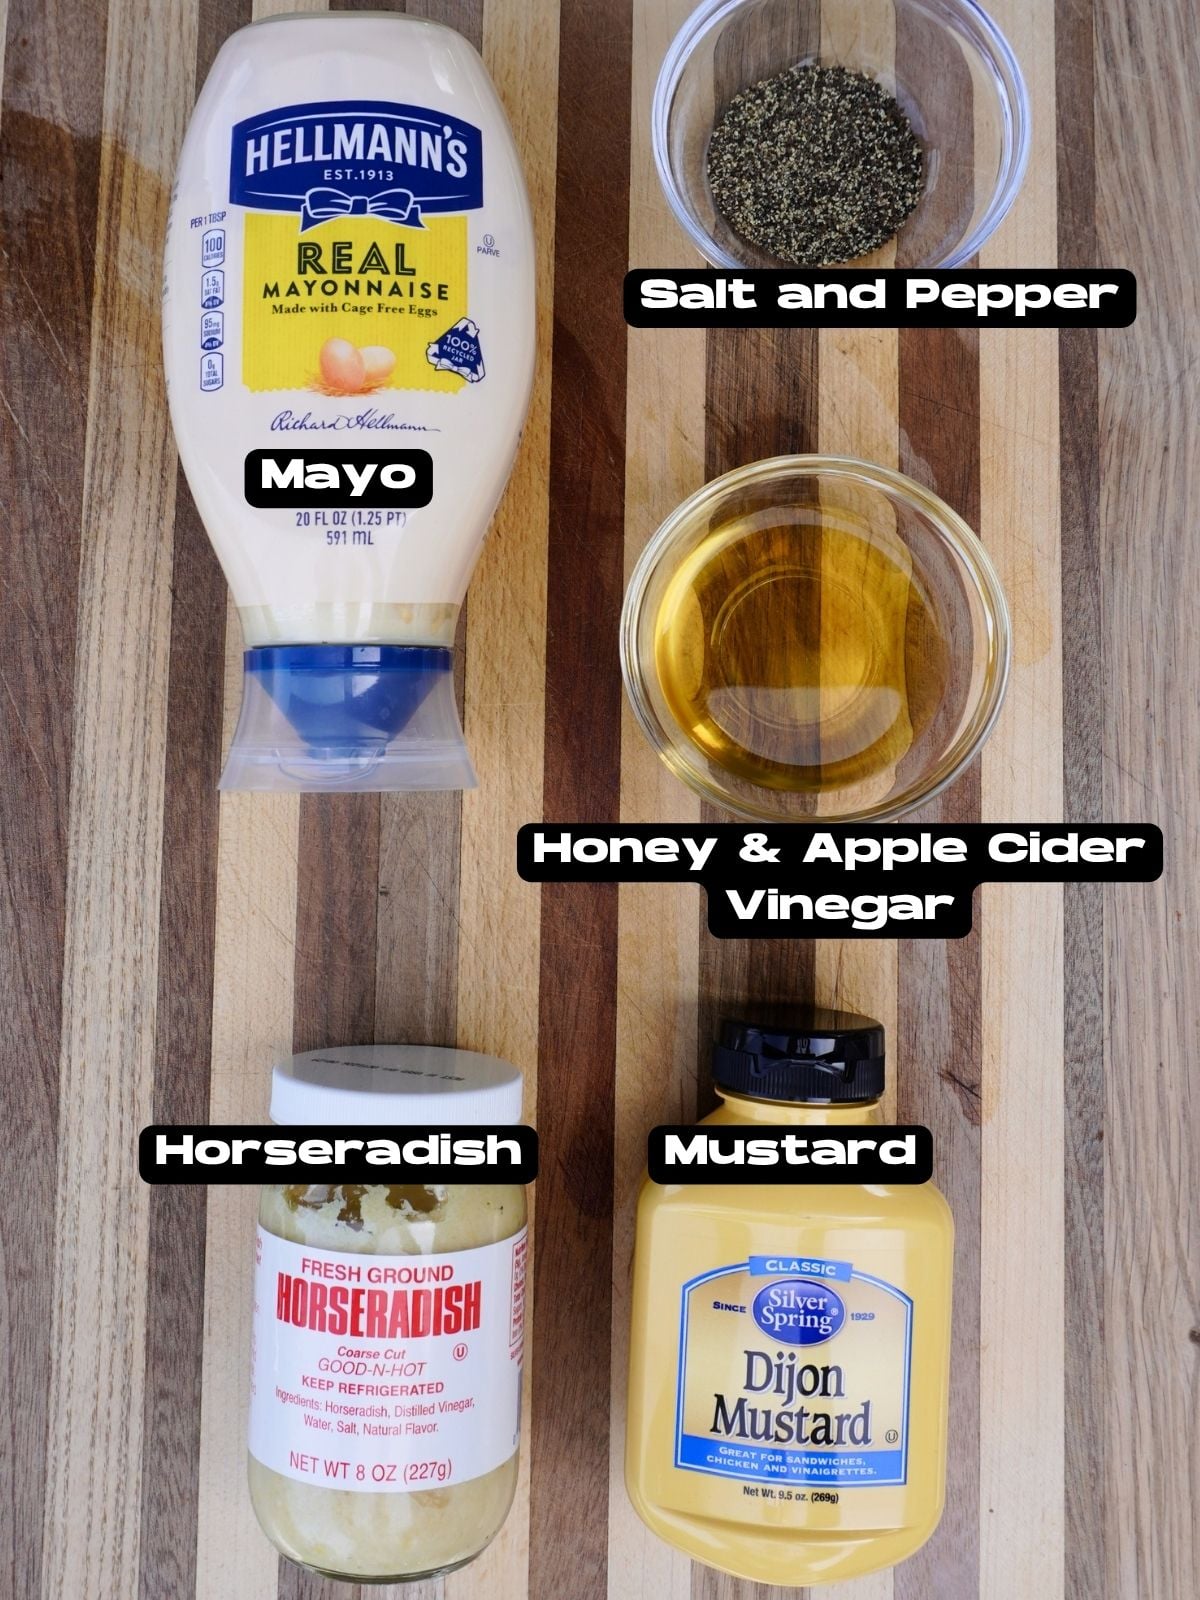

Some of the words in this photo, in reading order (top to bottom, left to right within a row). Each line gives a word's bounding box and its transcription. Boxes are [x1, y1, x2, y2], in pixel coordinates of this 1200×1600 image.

[245, 123, 468, 178] HELLMANN'S
[323, 168, 394, 181] EST.1913
[190, 216, 203, 229] PER
[208, 211, 227, 224] TBSP
[204, 236, 222, 253] 100
[476, 246, 500, 258] PARVE
[297, 241, 416, 276] REAL
[262, 279, 449, 301] MAYONNAISE
[272, 303, 306, 315] Made
[309, 302, 338, 314] with
[341, 302, 373, 317] Cage
[377, 303, 405, 314] Free
[408, 304, 438, 318] Eggs
[443, 344, 475, 362] RECYCLED
[446, 334, 478, 355] 100%
[451, 355, 464, 364] JAR
[270, 410, 347, 431] Richard
[347, 408, 441, 432] Hellmann
[296, 511, 310, 526] 20
[315, 511, 328, 526] FL
[333, 510, 347, 525] OZ
[352, 510, 382, 527] (1.25
[387, 511, 407, 528] PT)
[327, 530, 347, 546] 591
[302, 1258, 361, 1282] FRESH
[367, 1265, 454, 1284] GROUND
[766, 1260, 836, 1276] CLASSIC
[276, 1272, 482, 1339] HORSERADISH
[713, 1301, 747, 1314] SINCE
[768, 1289, 828, 1311] Silver
[850, 1312, 876, 1322] 1929
[337, 1346, 380, 1360] Coarse
[384, 1348, 406, 1360] Cut
[318, 1358, 428, 1377] GOOD-N-HOT
[302, 1375, 334, 1391] KEEP
[338, 1381, 445, 1397] REFRIGERATED
[743, 1350, 846, 1407] Dijon
[275, 1385, 323, 1412] Ingredients:
[325, 1401, 391, 1419] Horseradish,
[394, 1402, 435, 1418] Distilled
[438, 1397, 476, 1415] Vinegar,
[304, 1413, 334, 1433] Water,
[336, 1420, 360, 1436] Salt,
[363, 1423, 402, 1436] Natural
[405, 1422, 439, 1436] Flavor.
[710, 1394, 872, 1446] Mustard
[719, 1446, 757, 1460] GREAT
[760, 1453, 782, 1463] FOR
[290, 1450, 320, 1474] NET
[324, 1459, 351, 1480] WT
[356, 1464, 366, 1481] 8
[372, 1464, 397, 1482] OZ
[403, 1458, 453, 1486] (227g)
[706, 1455, 759, 1470] CHICKEN
[763, 1464, 788, 1474] AND
[743, 1486, 759, 1497] Net
[761, 1488, 776, 1499] Wt.
[778, 1490, 793, 1500] 9.5
[794, 1492, 809, 1502] oz.
[810, 1492, 839, 1505] (269g)
